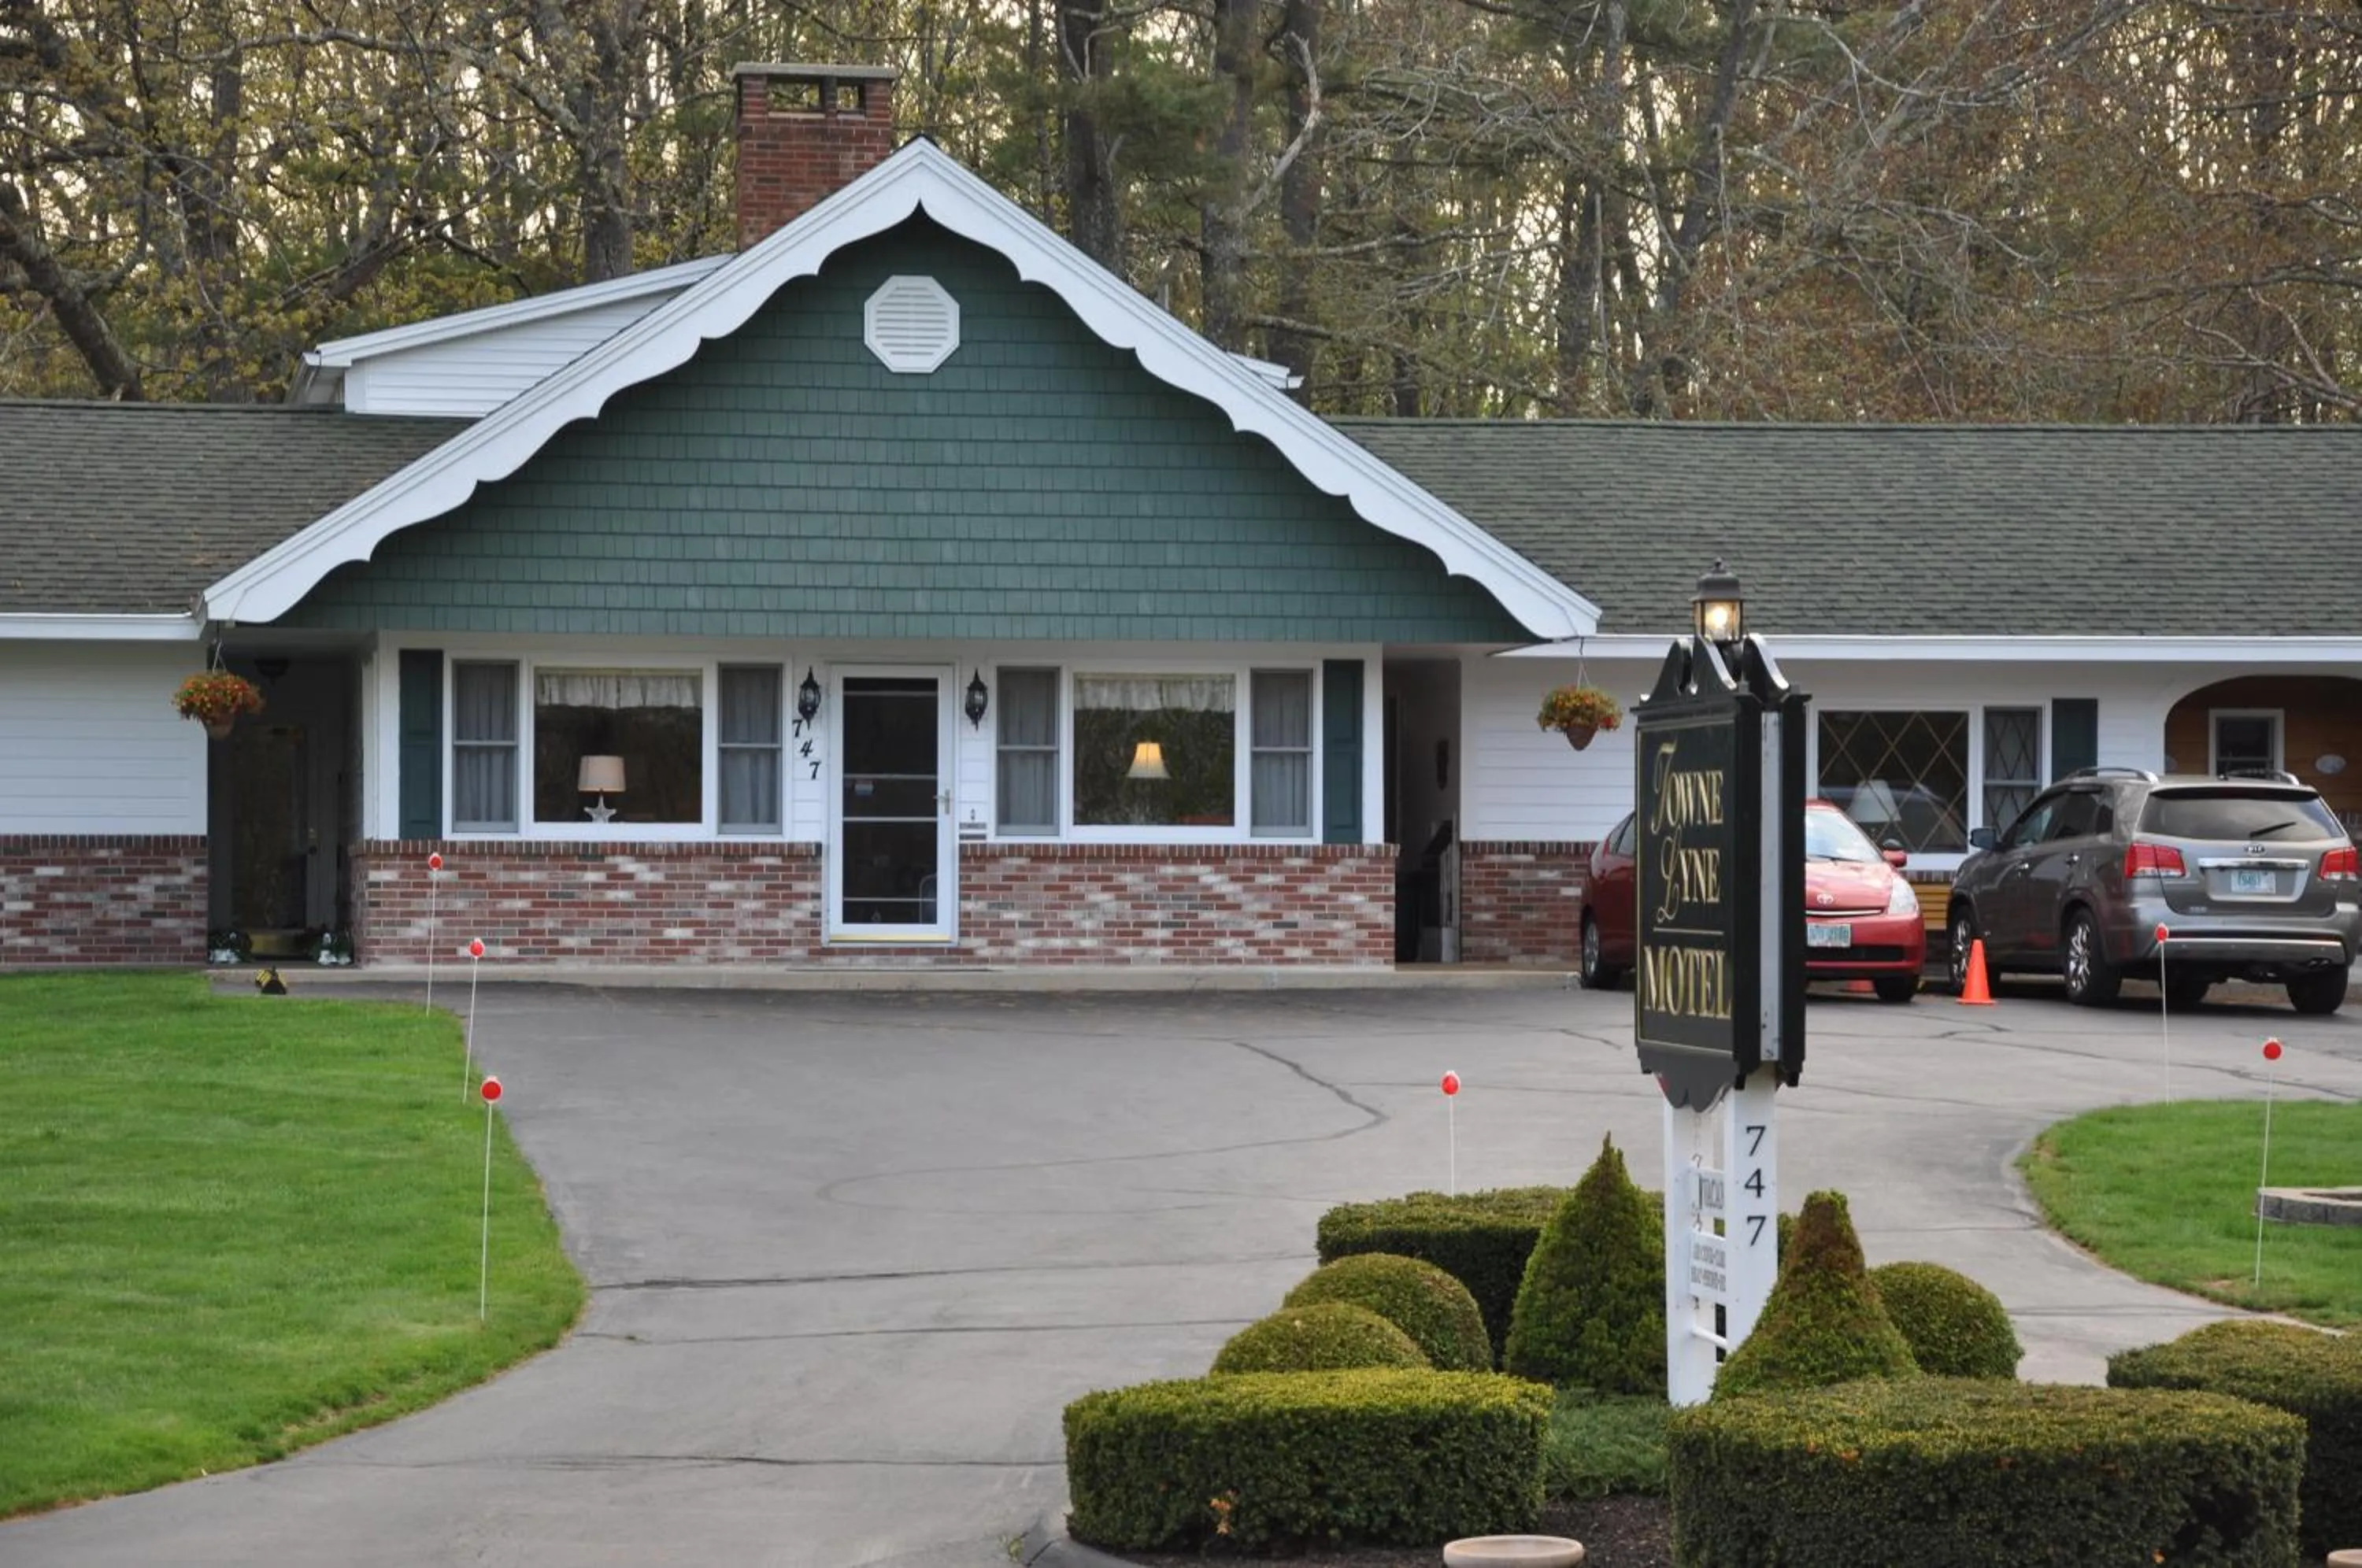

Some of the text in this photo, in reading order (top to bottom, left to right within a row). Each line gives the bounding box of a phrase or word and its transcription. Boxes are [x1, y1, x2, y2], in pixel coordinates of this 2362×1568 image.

[792, 719, 821, 780] 747
[1651, 739, 1723, 836] TOWNE
[1657, 824, 1720, 923] LYNE
[1642, 945, 1731, 1020] MOTEL
[1744, 1125, 1768, 1248] 747
